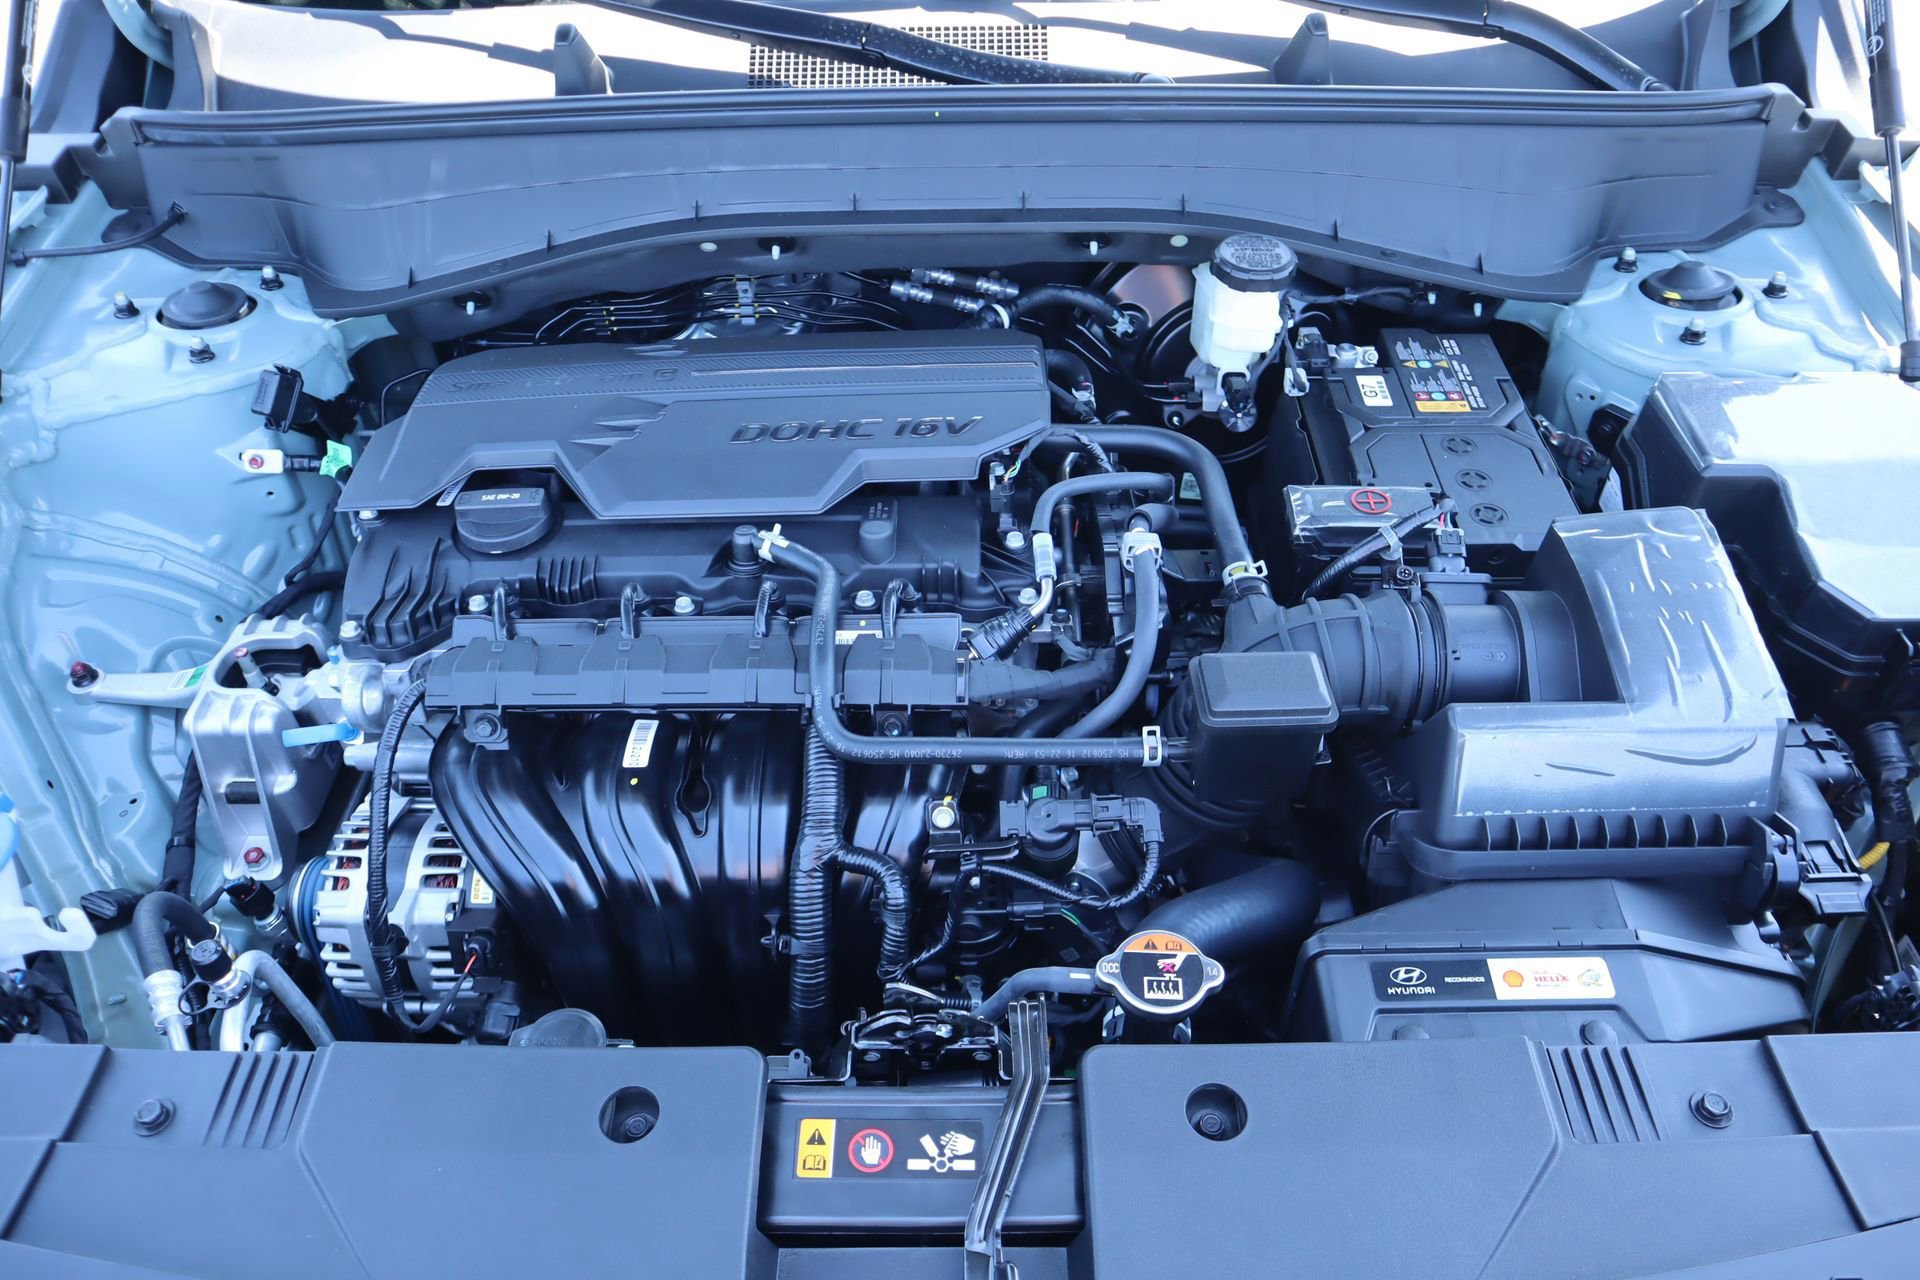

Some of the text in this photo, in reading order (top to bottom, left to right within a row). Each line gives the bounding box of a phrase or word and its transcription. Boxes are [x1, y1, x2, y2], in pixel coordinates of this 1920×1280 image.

[654, 367, 678, 382] G
[1361, 383, 1379, 398] G7
[728, 415, 984, 445] DOHC 16V
[480, 493, 496, 501] SAE
[889, 749, 899, 759] HS
[1534, 974, 1569, 983] HELIX
[1387, 986, 1436, 995] HYUNDAI
